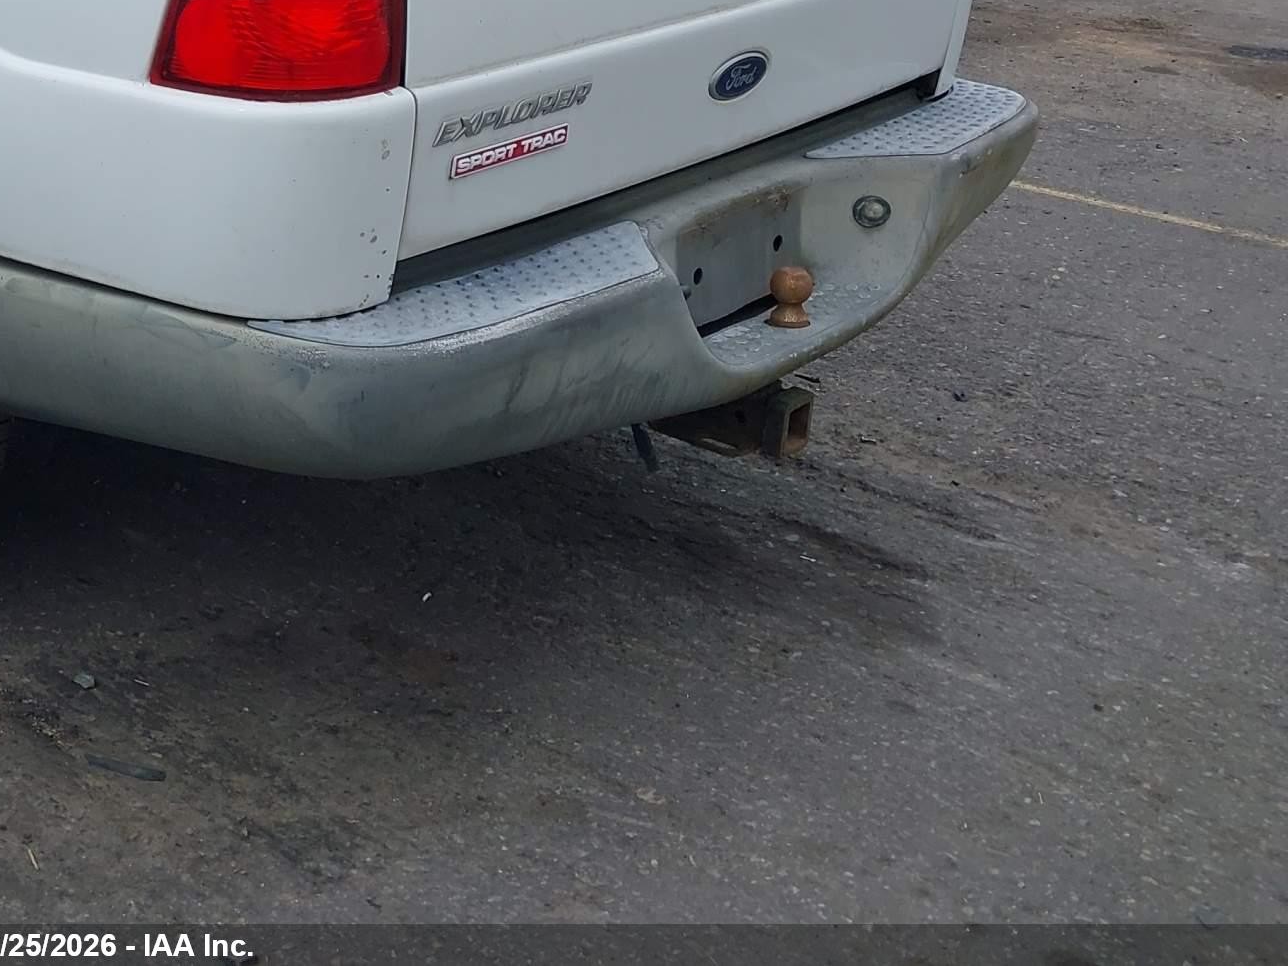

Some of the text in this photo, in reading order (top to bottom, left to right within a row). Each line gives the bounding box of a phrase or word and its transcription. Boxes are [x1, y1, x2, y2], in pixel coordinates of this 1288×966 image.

[431, 81, 593, 148] EXPLORER
[455, 128, 567, 174] SPORT TRAC
